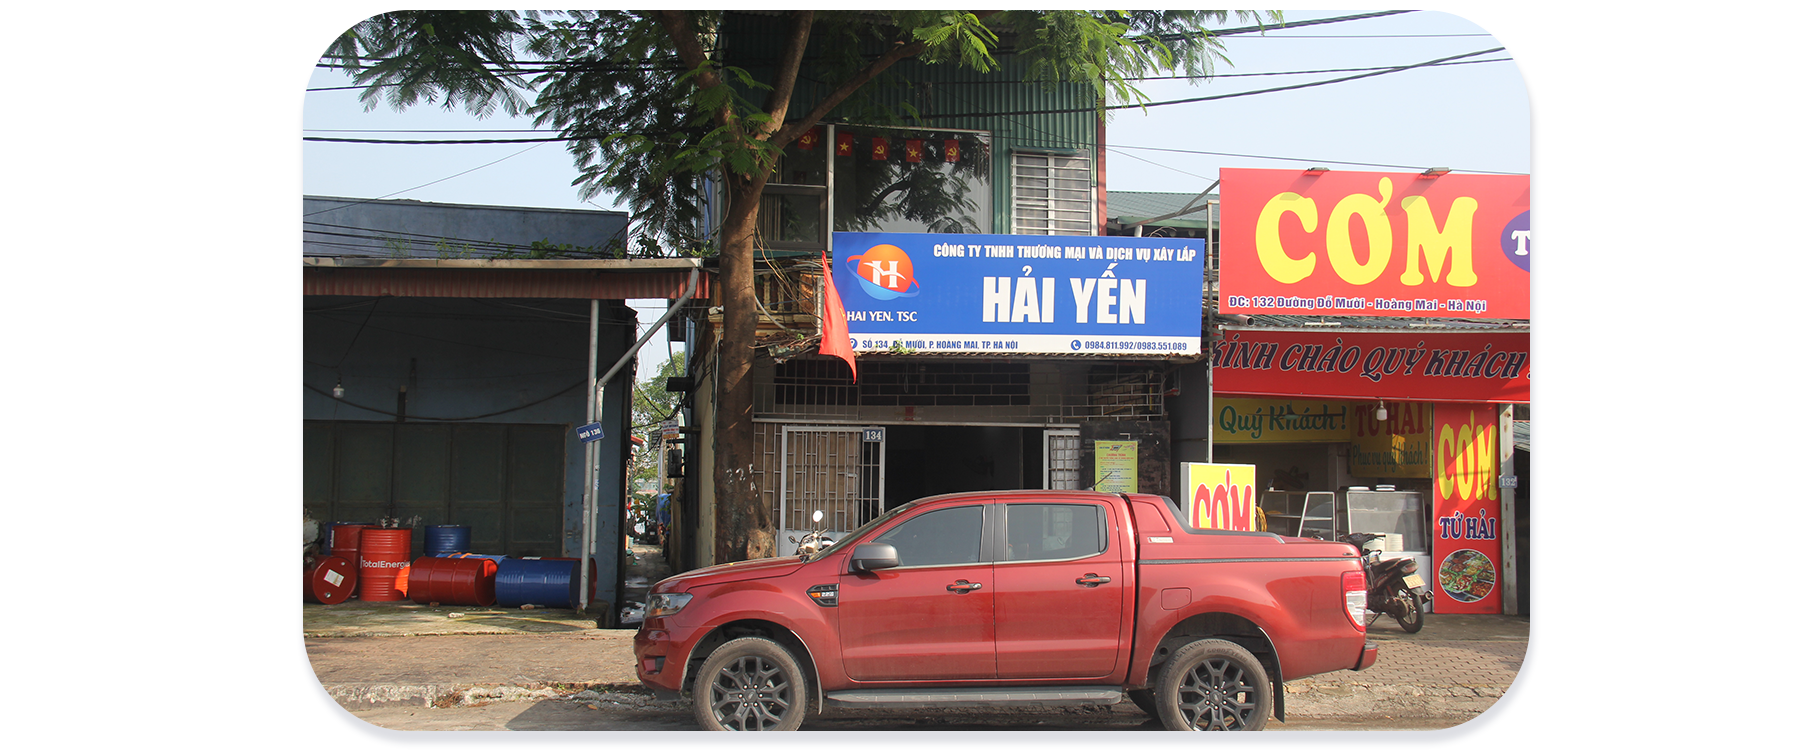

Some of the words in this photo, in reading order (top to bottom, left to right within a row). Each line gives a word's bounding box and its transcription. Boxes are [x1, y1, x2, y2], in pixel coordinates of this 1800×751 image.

[1255, 176, 1479, 287] CƠM
[933, 242, 965, 258] CÔNG
[967, 245, 982, 258] TY
[984, 245, 1014, 258] TNHH
[1016, 244, 1062, 259] THƯƠNG
[1064, 246, 1086, 261] MẠI
[1088, 245, 1104, 260] VÀ
[1106, 247, 1133, 262] DỊCH
[1135, 248, 1151, 263] VỤ
[1153, 246, 1175, 261] XÂY
[1176, 245, 1197, 262] LẮP
[863, 260, 906, 288] H
[982, 265, 1056, 323] HẢI
[1069, 262, 1147, 324] YẾN
[1229, 296, 1250, 307] ĐC:
[1252, 297, 1274, 307] 132
[1276, 297, 1314, 309] Đường
[1316, 295, 1332, 308] Đỗ
[1335, 298, 1365, 309] Mười
[1375, 298, 1412, 311] Hoàng
[1415, 299, 1438, 310] Mai
[1448, 299, 1463, 311] Hà
[1466, 300, 1486, 313] Nội
[846, 311, 866, 322] HAI
[868, 311, 894, 322] YEN.
[896, 311, 918, 322] TSC
[1084, 340, 1187, 351] 0984.811.992/0983.551.089
[1213, 333, 1279, 369] KÍNH
[1279, 337, 1361, 373] CHÀO
[1360, 340, 1426, 382] QUÝ
[1423, 343, 1527, 378] KHÁCH
[865, 430, 882, 440] 134
[1219, 405, 1263, 439] Quý
[1269, 404, 1338, 431] Khách
[1352, 443, 1371, 470] Phục
[1437, 409, 1497, 501] CƠM
[1439, 510, 1464, 539] TỨ
[1465, 508, 1496, 540] HẢI
